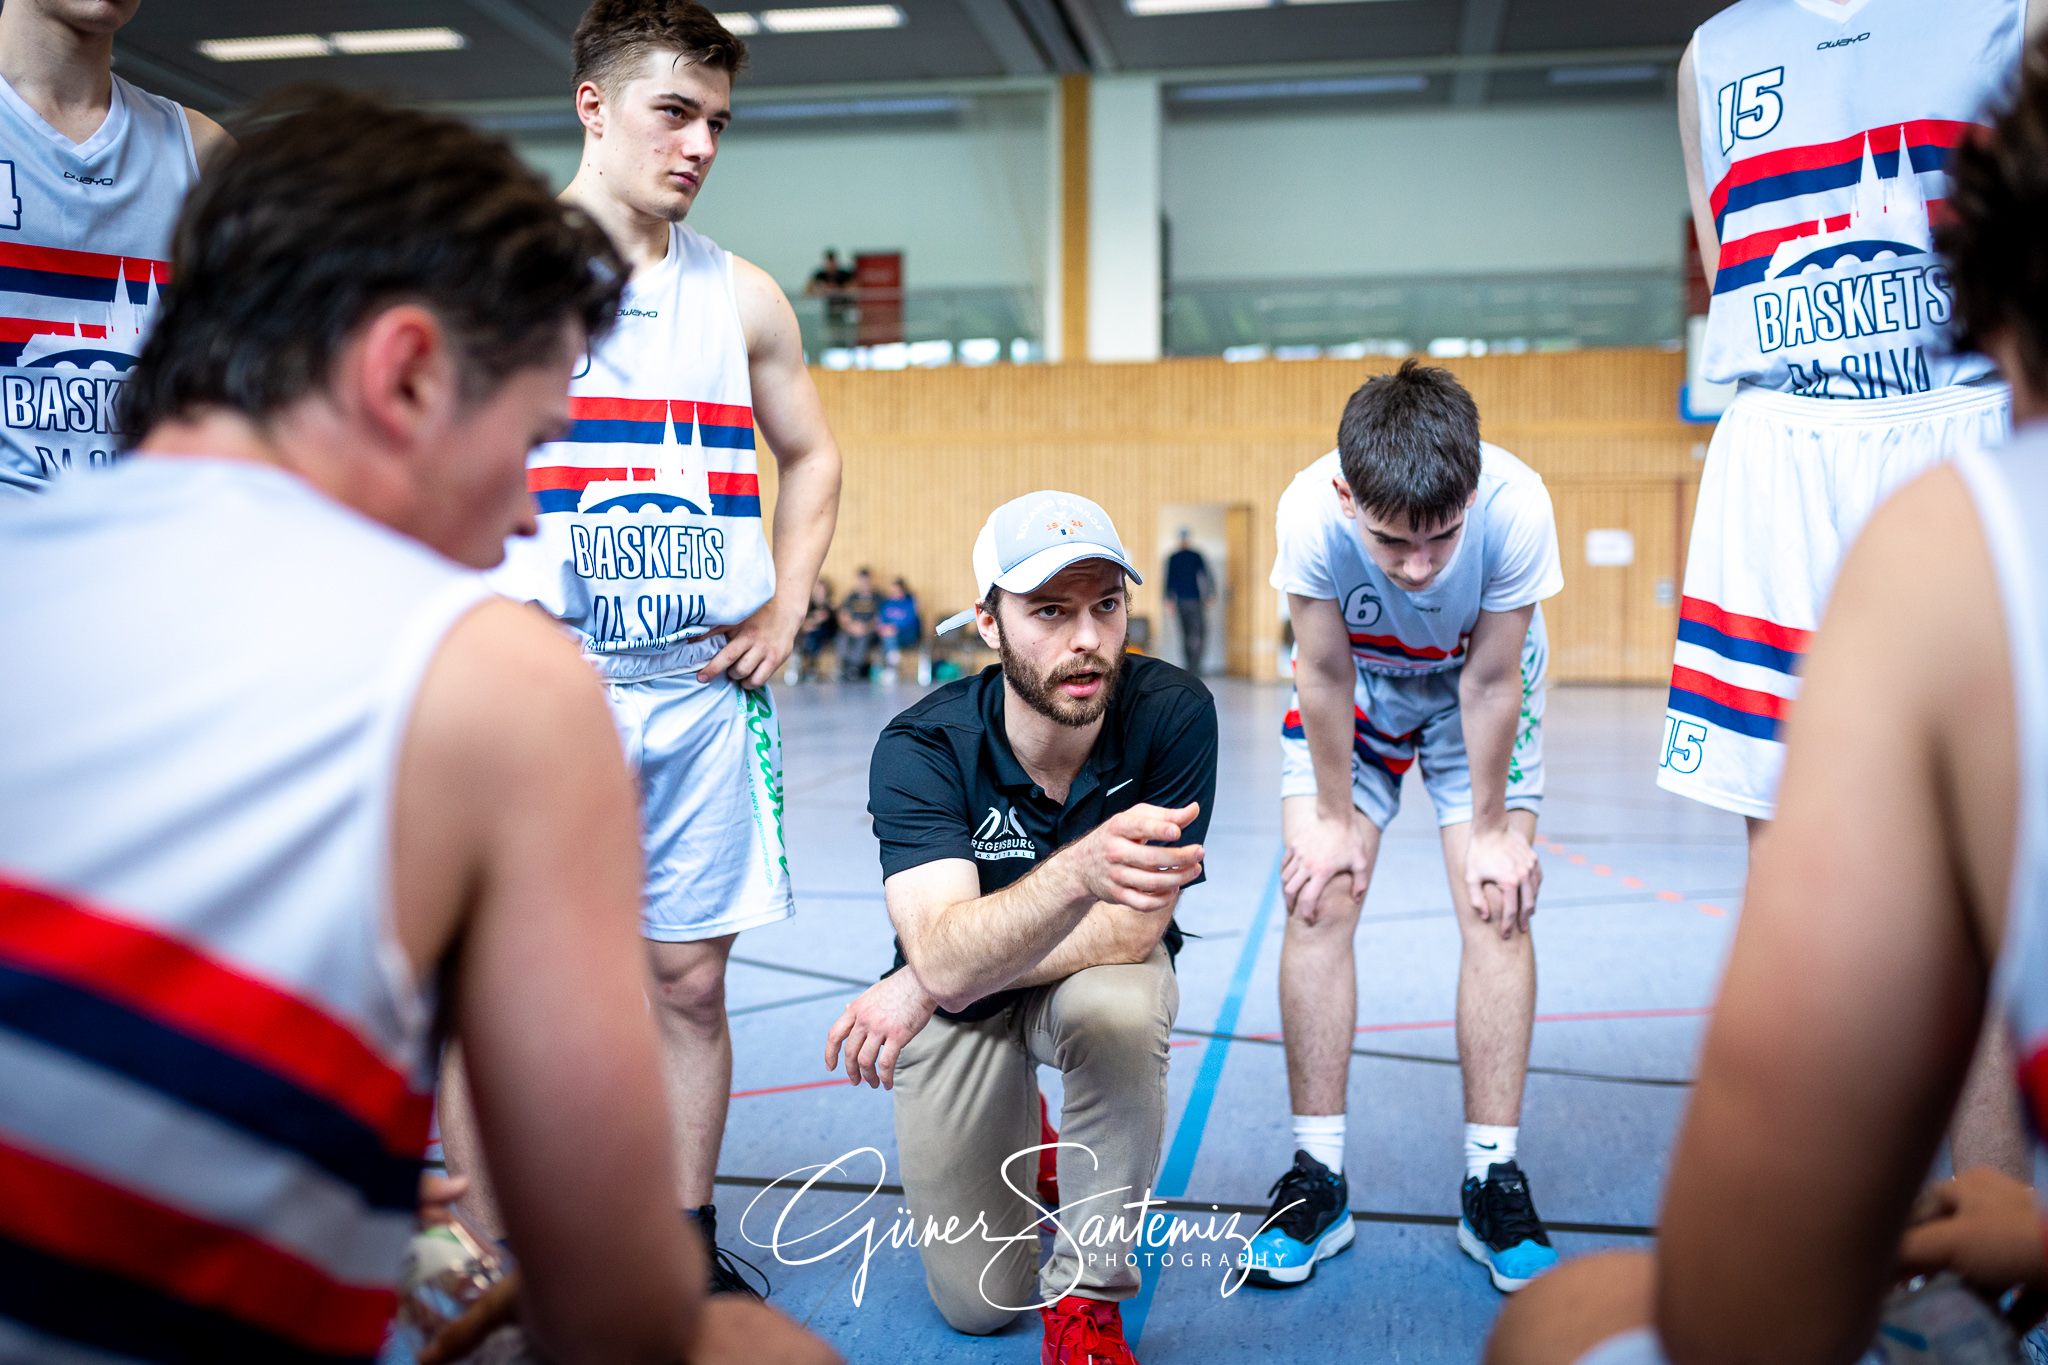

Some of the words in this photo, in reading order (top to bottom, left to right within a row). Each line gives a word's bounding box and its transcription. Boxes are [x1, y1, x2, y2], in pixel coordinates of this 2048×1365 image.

[1718, 65, 1785, 156] 15
[1754, 264, 1953, 354] BASKETS
[3, 375, 123, 434] BASK
[571, 525, 724, 580] BASKETS
[593, 595, 626, 642] DA
[637, 594, 706, 640] SILVA
[1343, 582, 1382, 628] 6
[1659, 715, 1707, 774] 15
